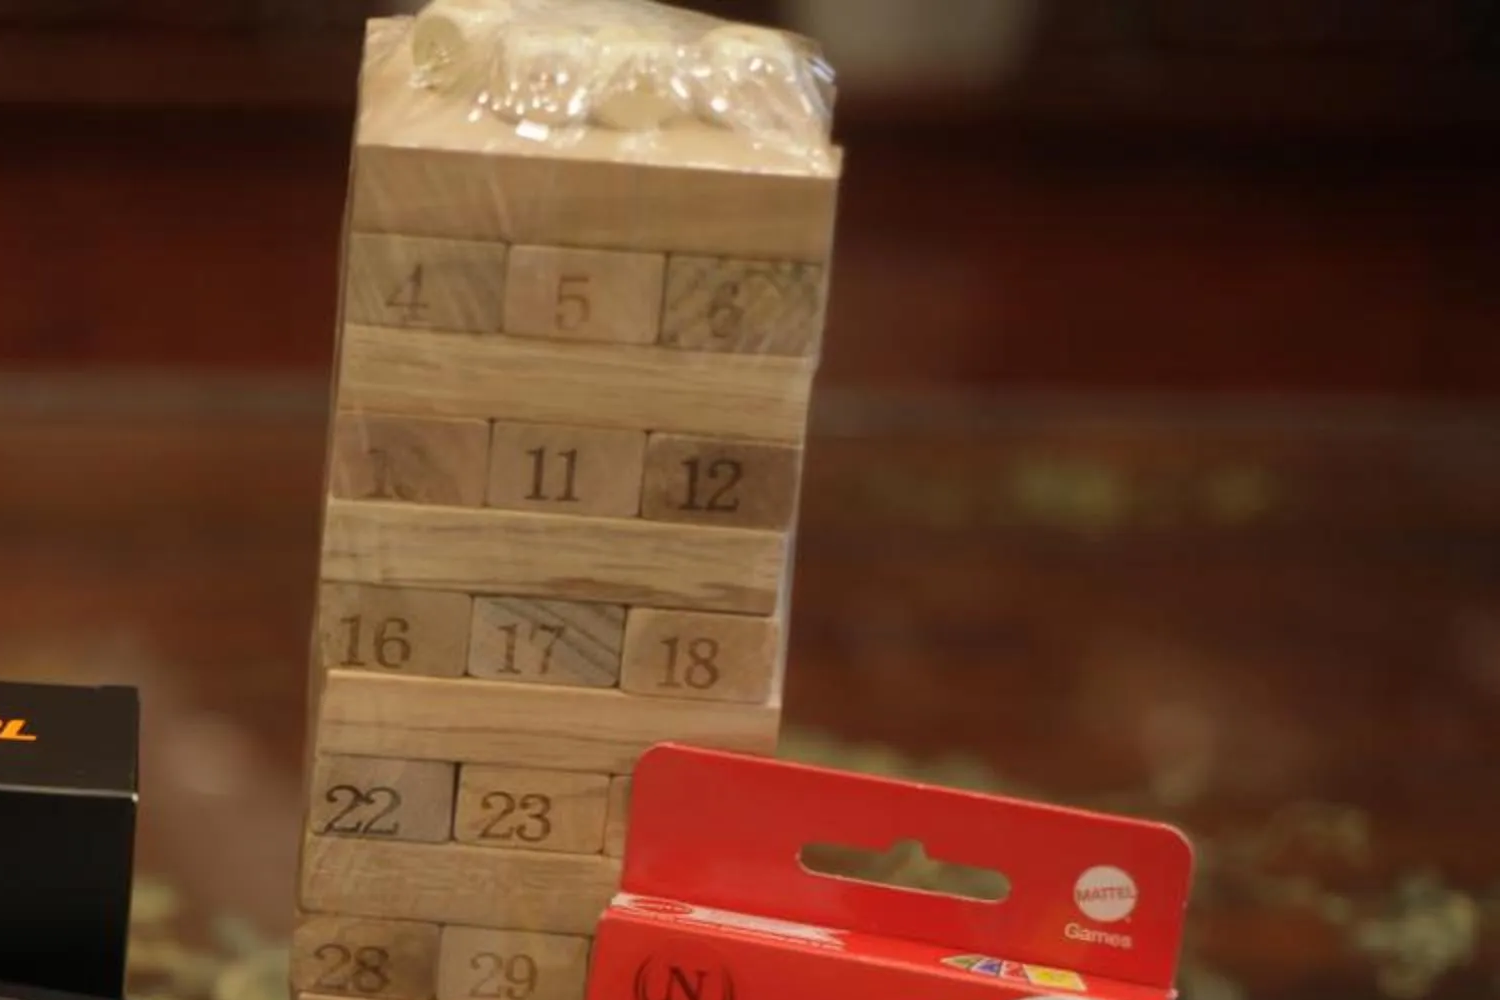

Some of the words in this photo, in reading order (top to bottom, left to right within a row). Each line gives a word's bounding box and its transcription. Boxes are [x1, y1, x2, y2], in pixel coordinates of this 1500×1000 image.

[385, 263, 430, 327] 4
[553, 275, 591, 331] 5
[524, 446, 579, 502] 11
[679, 455, 744, 513] 12
[340, 614, 412, 670] 16
[498, 622, 566, 676] 17
[660, 634, 722, 691] 18
[324, 783, 401, 837] 22
[479, 791, 553, 843] 23
[1064, 922, 1133, 949] Games
[313, 943, 391, 995] 28
[470, 952, 539, 1000] 29
